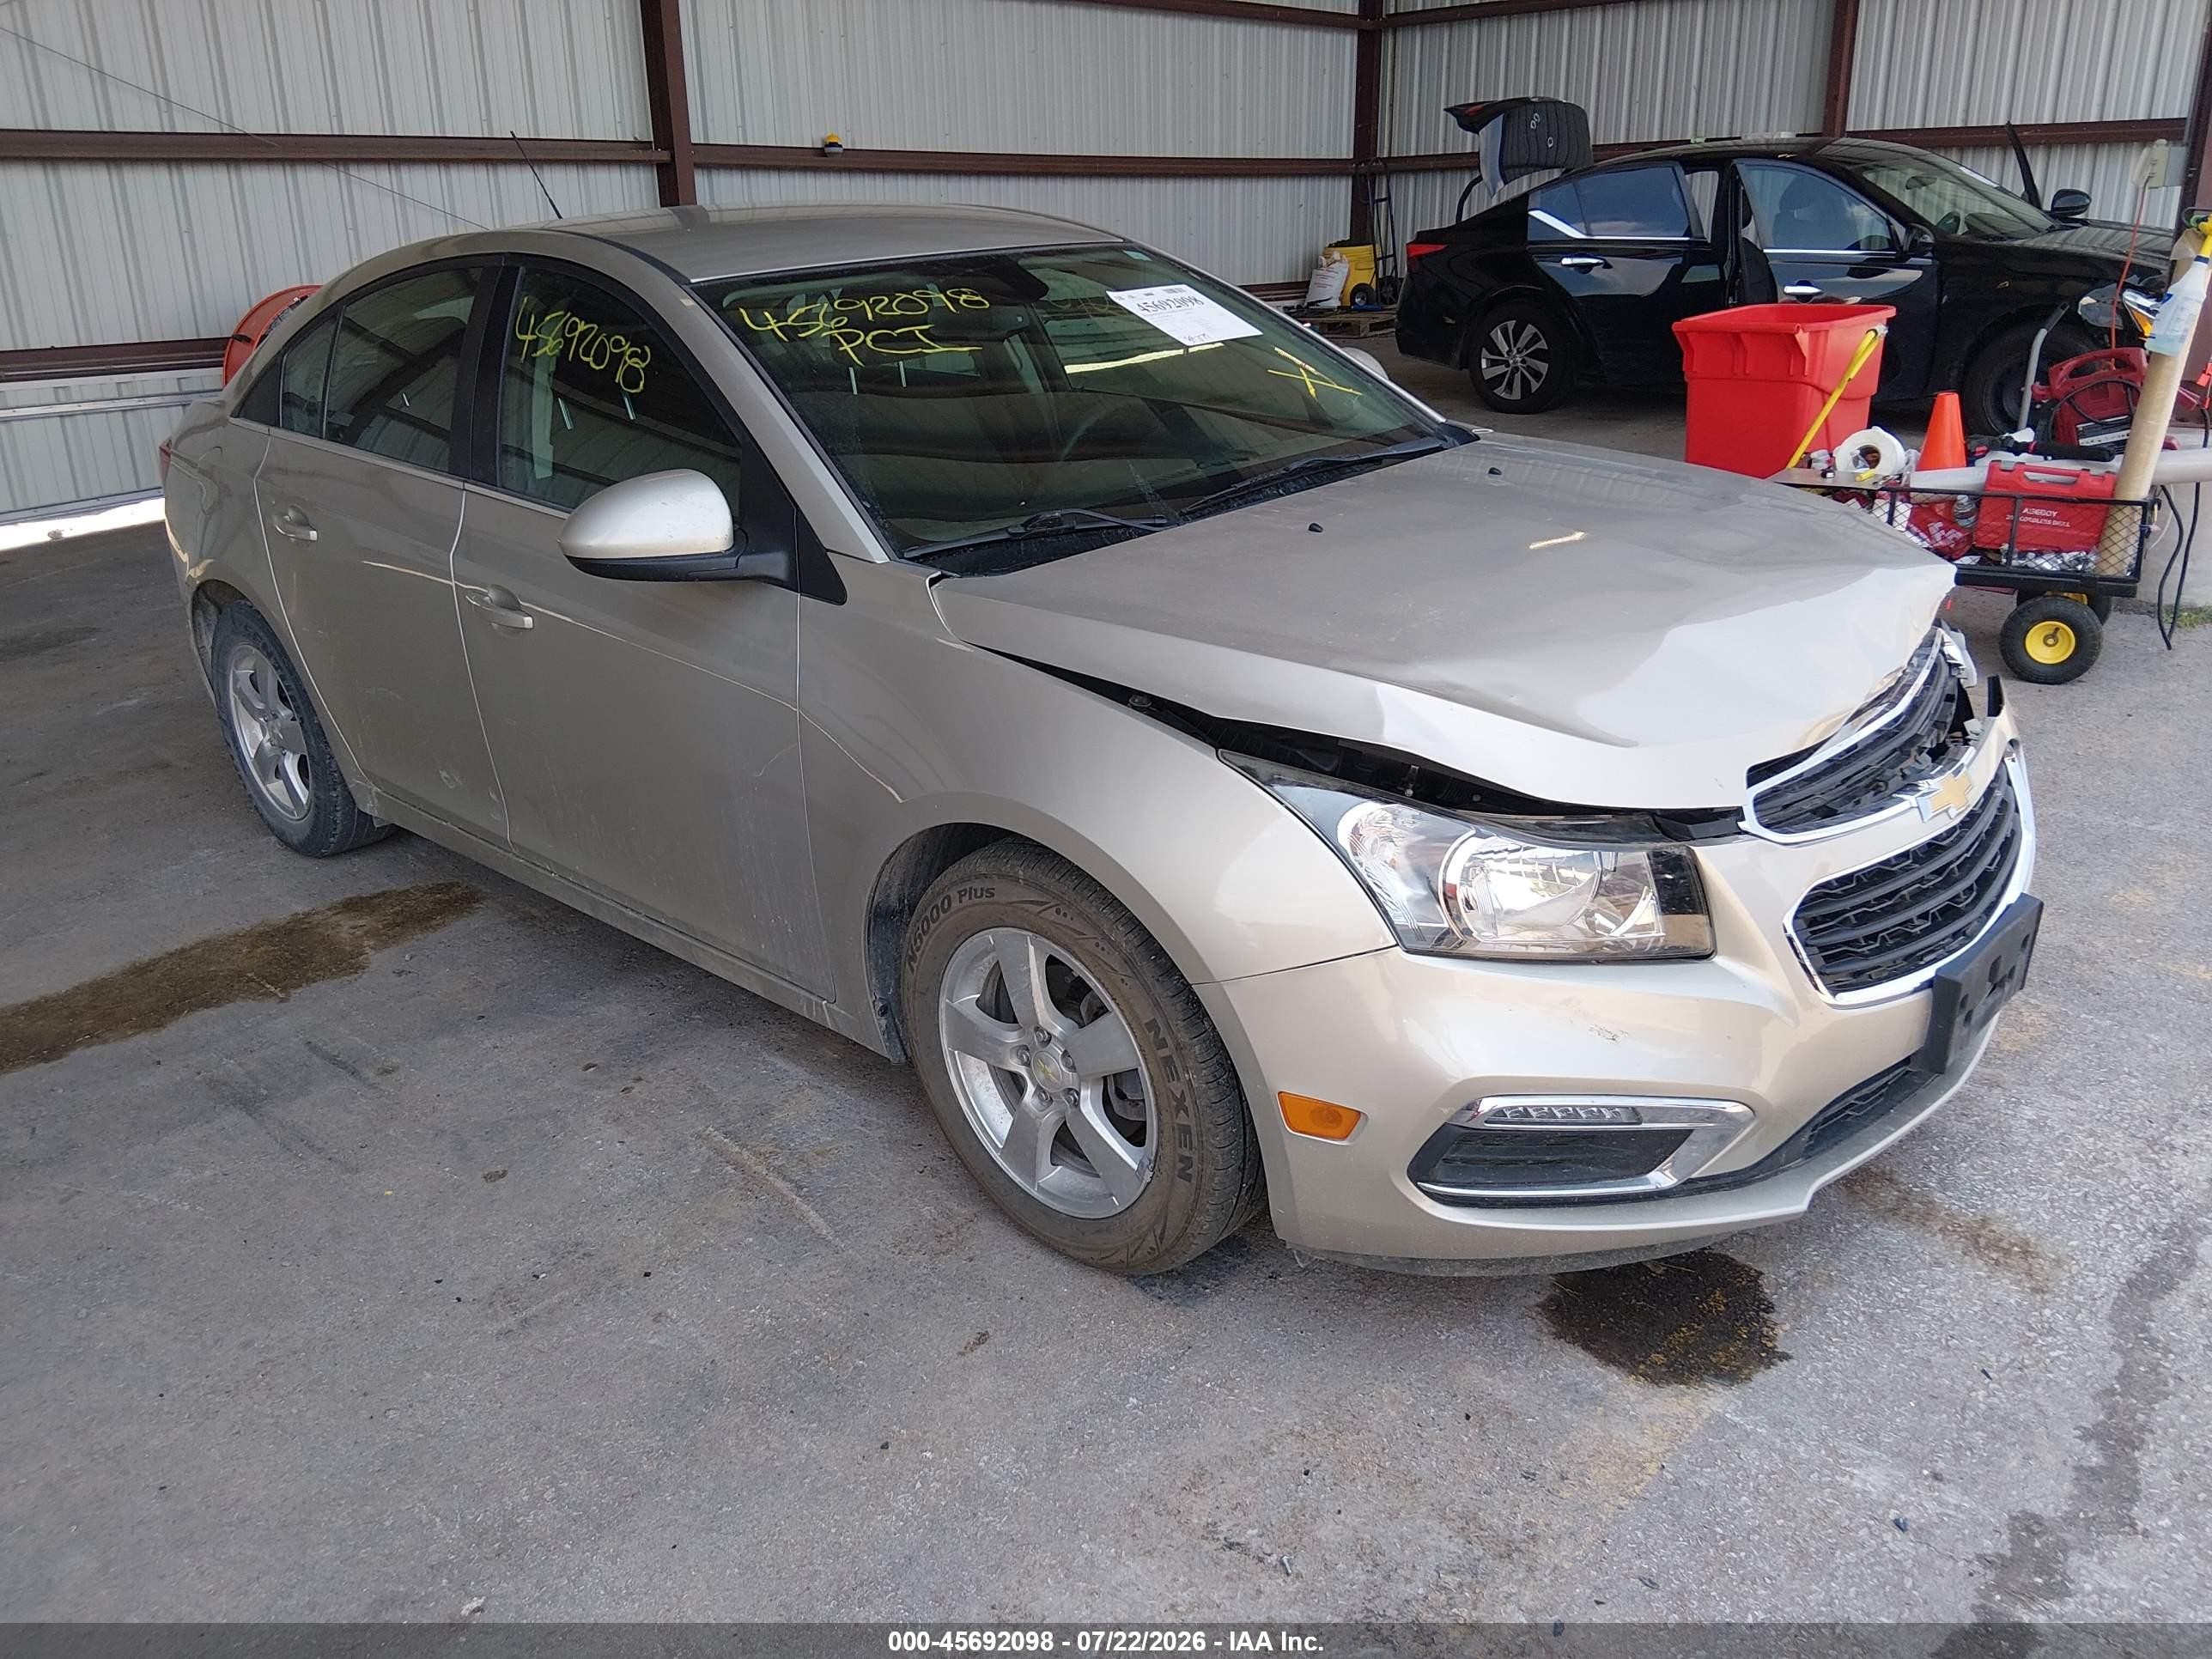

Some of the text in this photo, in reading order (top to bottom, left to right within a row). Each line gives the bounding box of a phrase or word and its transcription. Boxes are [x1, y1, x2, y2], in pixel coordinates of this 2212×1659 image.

[515, 296, 652, 393] 45692098
[739, 289, 989, 343] 45692098
[1136, 295, 1204, 313] 45692098
[908, 885, 996, 975] N5000 Plus
[1144, 1018, 1194, 1183] NEXEN
